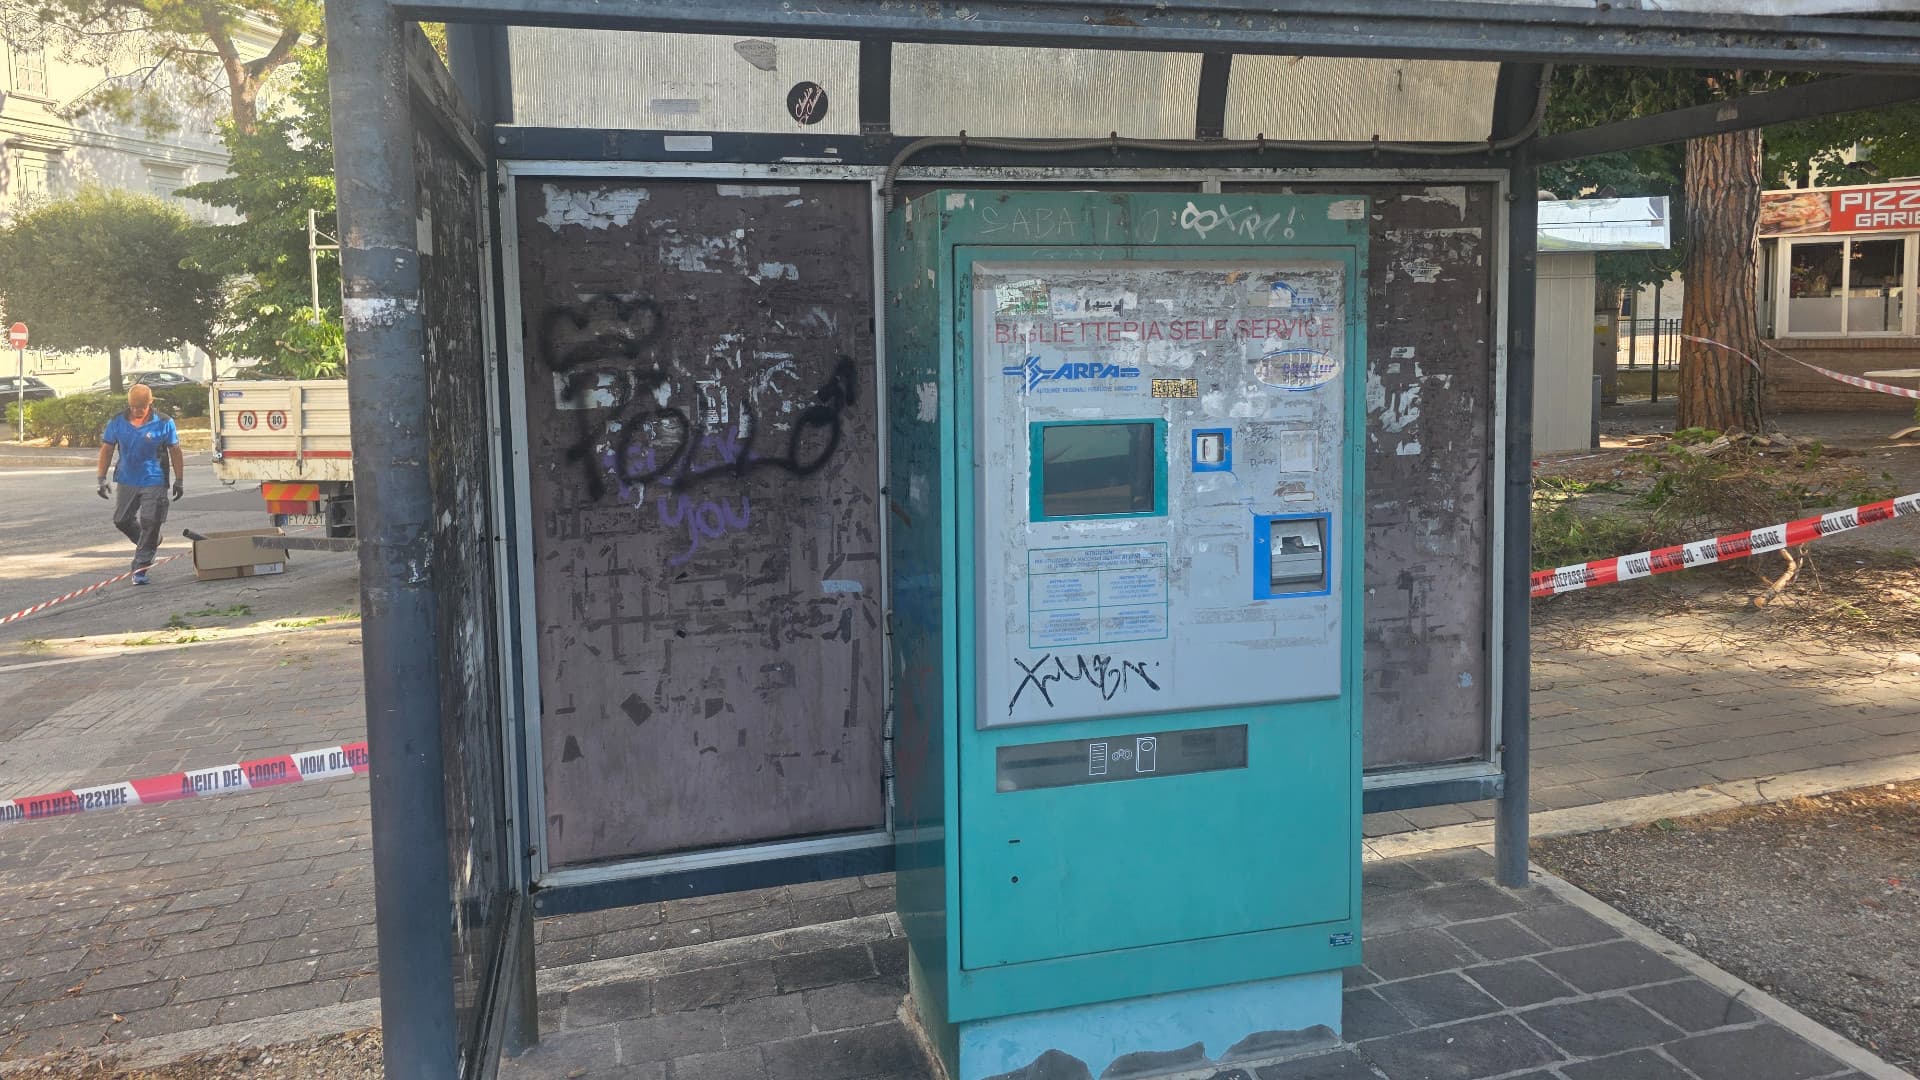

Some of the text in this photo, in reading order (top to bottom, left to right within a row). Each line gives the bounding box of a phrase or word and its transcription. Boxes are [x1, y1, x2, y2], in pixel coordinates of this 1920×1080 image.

[1840, 190, 1920, 212] PIZZ
[1168, 318, 1228, 341] SELF
[1236, 317, 1335, 341] SERVICE
[1050, 362, 1120, 379] ARPA
[243, 415, 253, 425] 70
[1840, 514, 1858, 529] DEL
[1625, 555, 1651, 575] VIGILI
